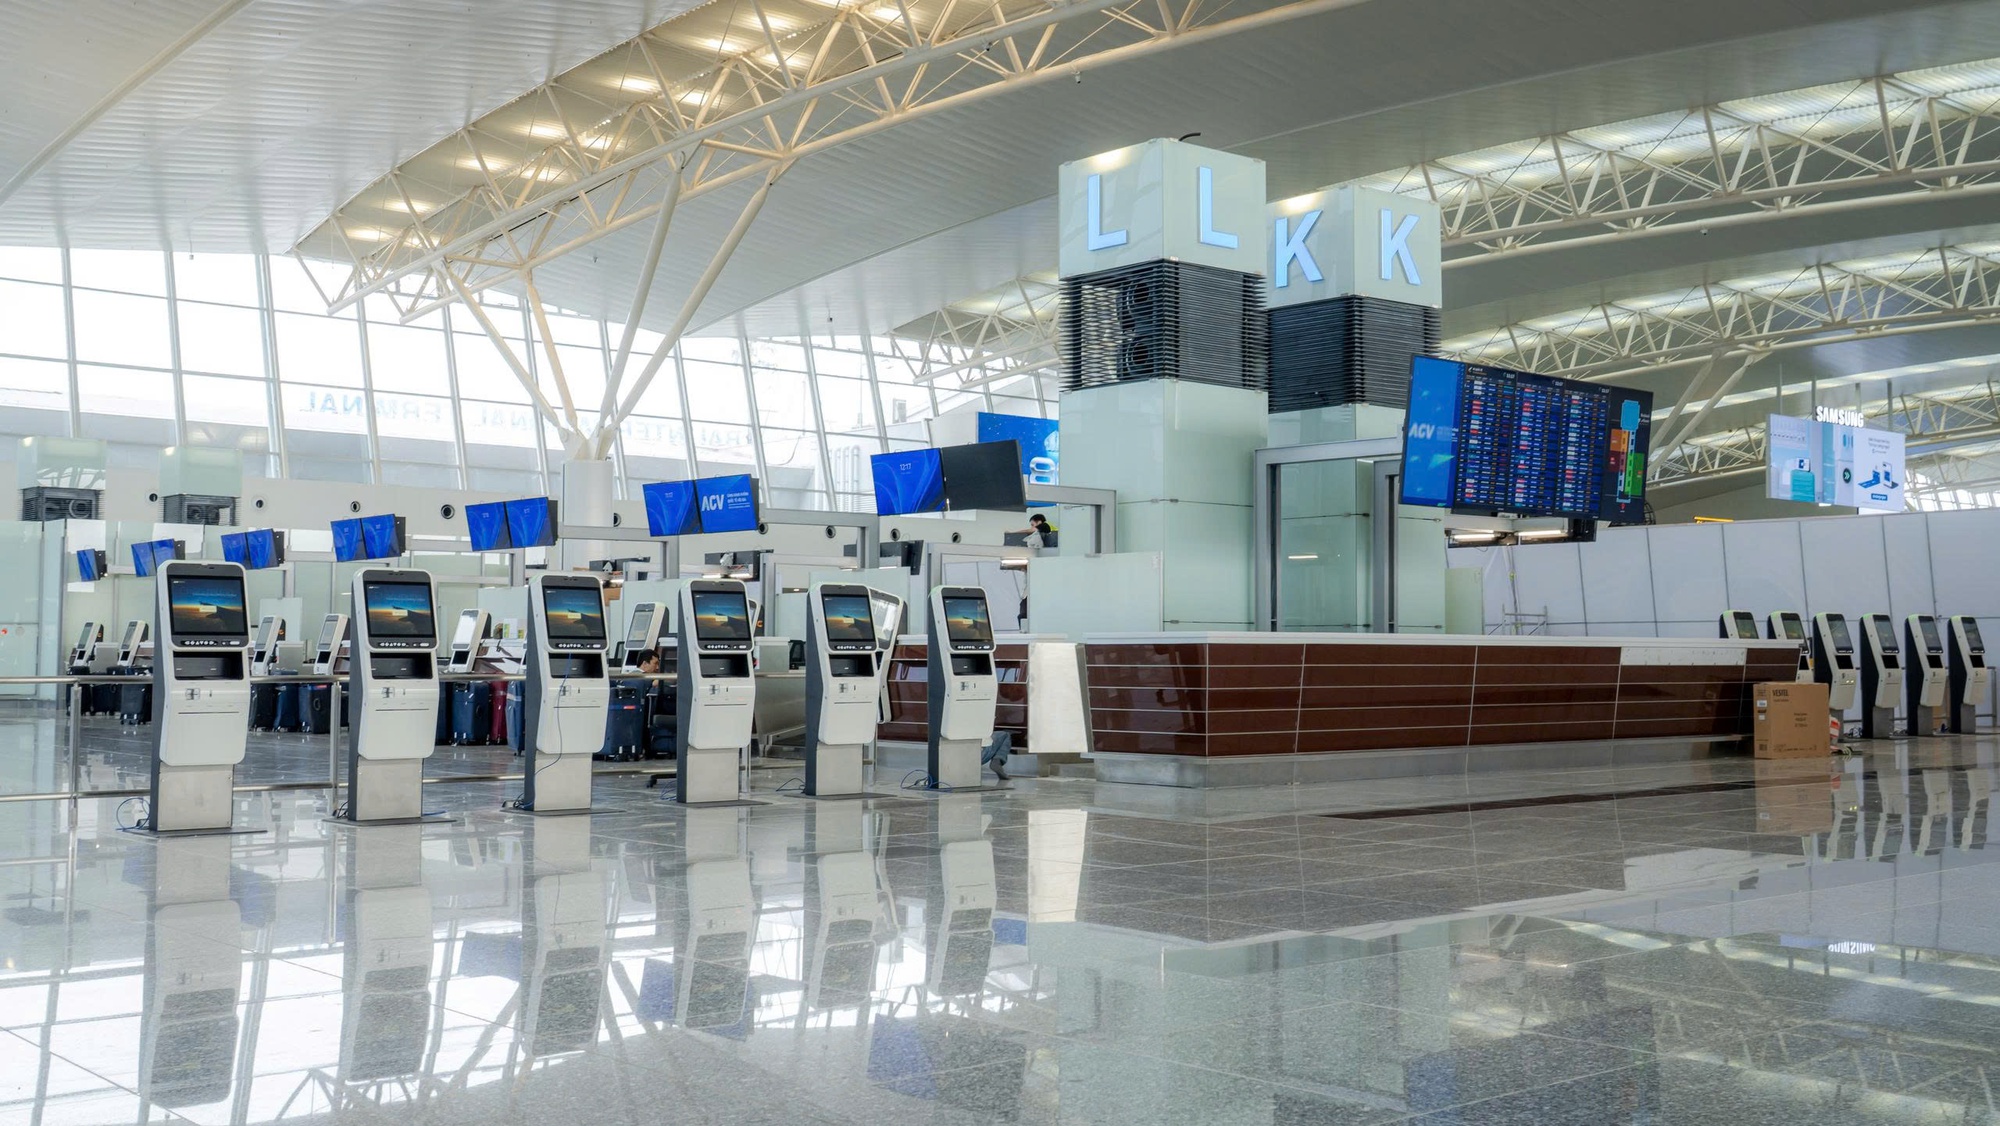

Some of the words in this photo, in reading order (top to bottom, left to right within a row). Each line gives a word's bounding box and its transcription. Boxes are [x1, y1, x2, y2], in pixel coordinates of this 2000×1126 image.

[1087, 174, 1128, 251] L
[1199, 166, 1239, 249] L
[1275, 209, 1324, 288] K
[1379, 208, 1422, 285] K
[1408, 422, 1436, 440] ACV
[1816, 405, 1864, 428] SAMSUNG
[701, 494, 725, 511] ACV
